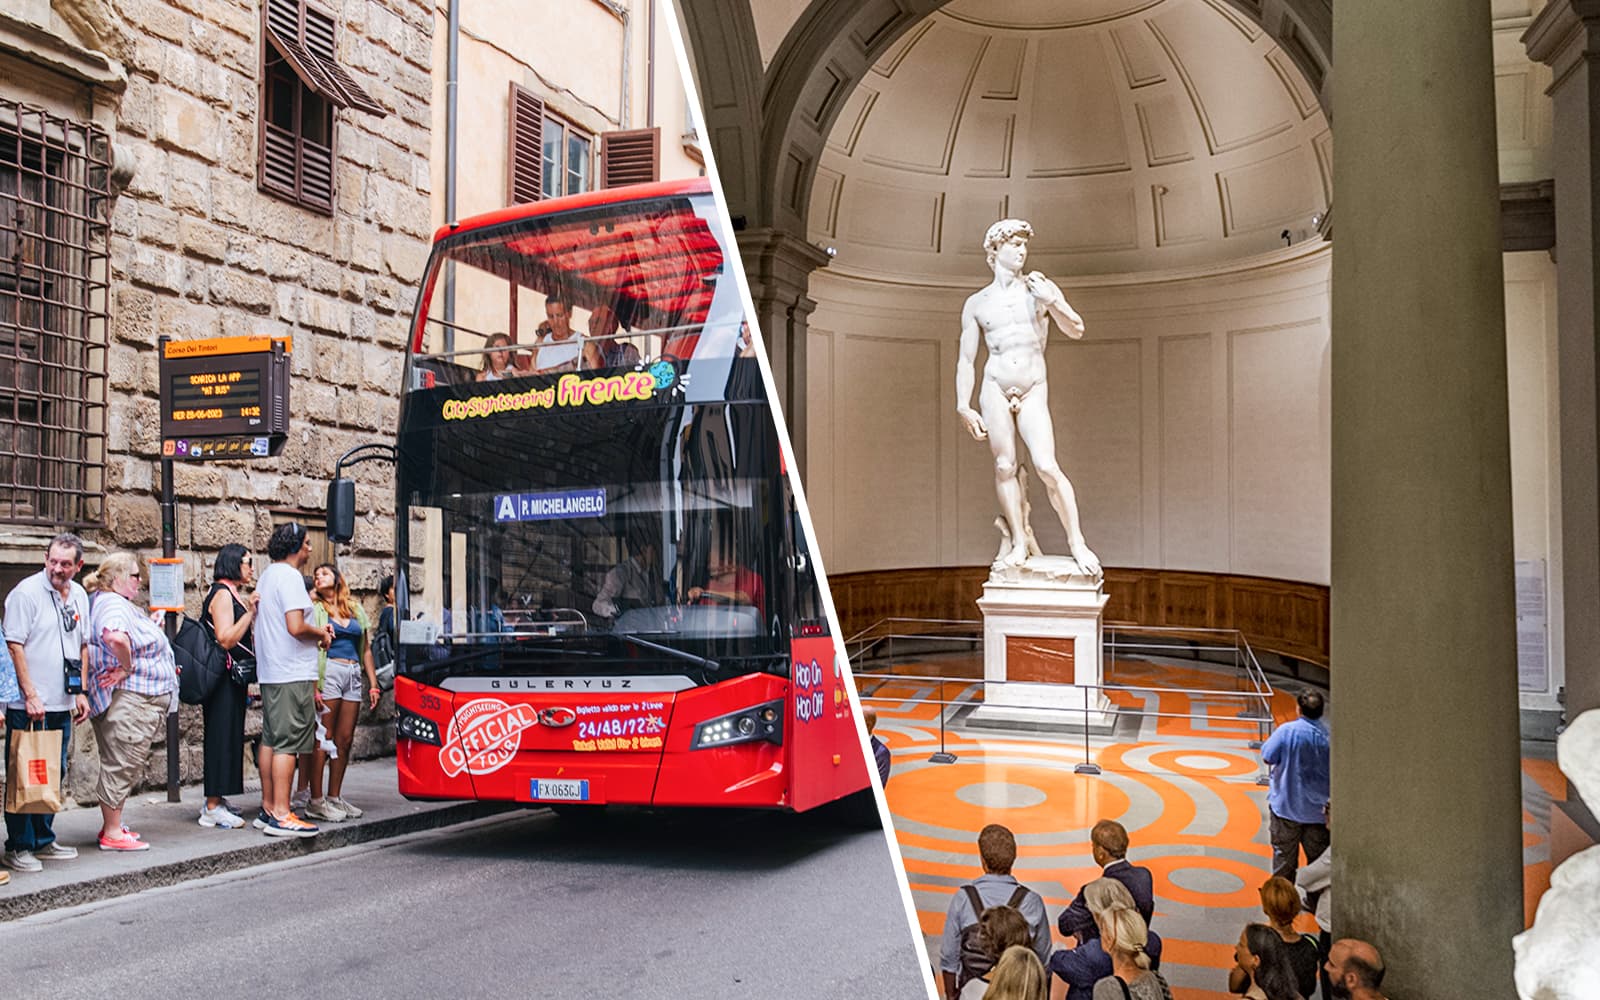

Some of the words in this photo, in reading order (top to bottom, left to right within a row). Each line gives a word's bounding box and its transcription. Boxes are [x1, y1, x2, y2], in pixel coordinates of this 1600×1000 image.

[167, 346, 186, 354] Corso
[187, 345, 197, 353] Dei
[190, 374, 217, 384] SCARICA
[218, 373, 227, 382] LA
[229, 371, 241, 382] APP
[498, 495, 516, 519] A
[522, 500, 529, 515] P.
[531, 495, 604, 515] MICHELANGELO
[795, 663, 811, 691] Hop
[811, 658, 823, 686] On
[419, 695, 441, 710] 353
[796, 694, 812, 723] Hop
[812, 691, 824, 719] Off
[448, 708, 532, 767] OFFICIAL
[579, 717, 645, 738] 24/48/72
[480, 739, 516, 768] TOUR
